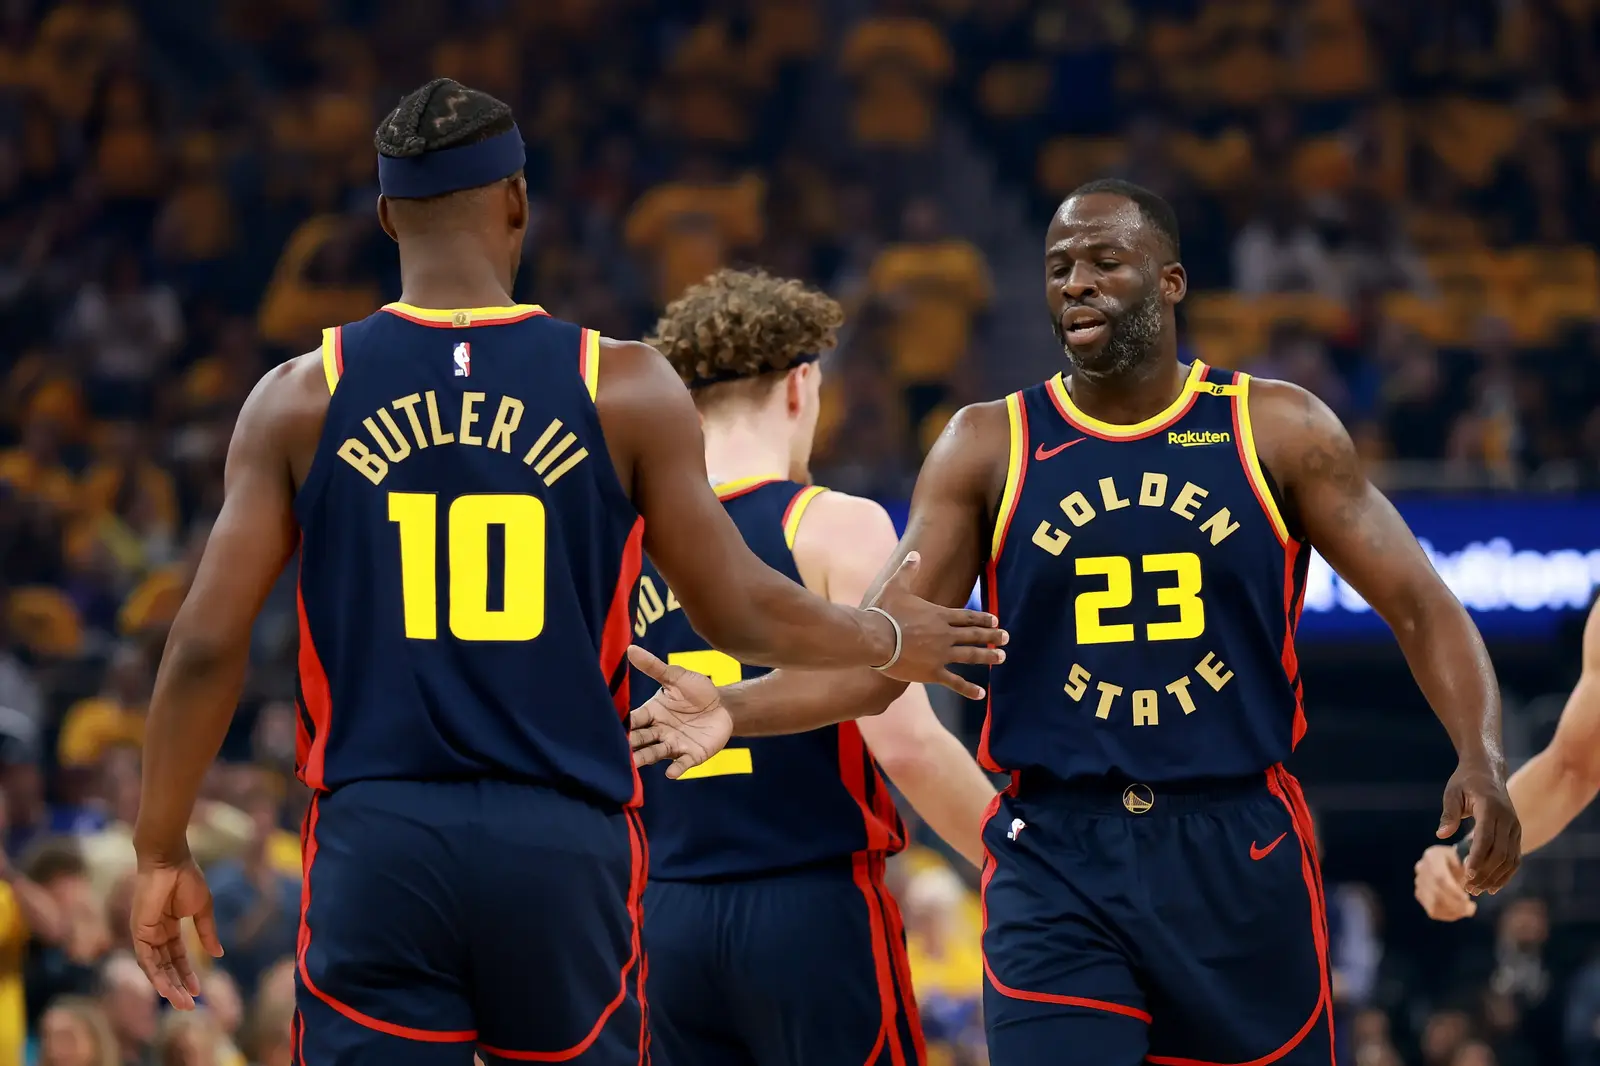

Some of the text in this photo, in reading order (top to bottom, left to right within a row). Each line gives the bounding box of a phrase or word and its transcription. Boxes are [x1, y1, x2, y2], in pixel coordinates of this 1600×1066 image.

[1211, 385, 1224, 394] 16
[336, 390, 589, 487] BUTLER III
[1167, 430, 1230, 447] Rakuten
[1031, 472, 1241, 556] GOLDEN
[388, 492, 546, 642] 10
[1074, 552, 1206, 645] 23
[1063, 650, 1235, 727] STATE
